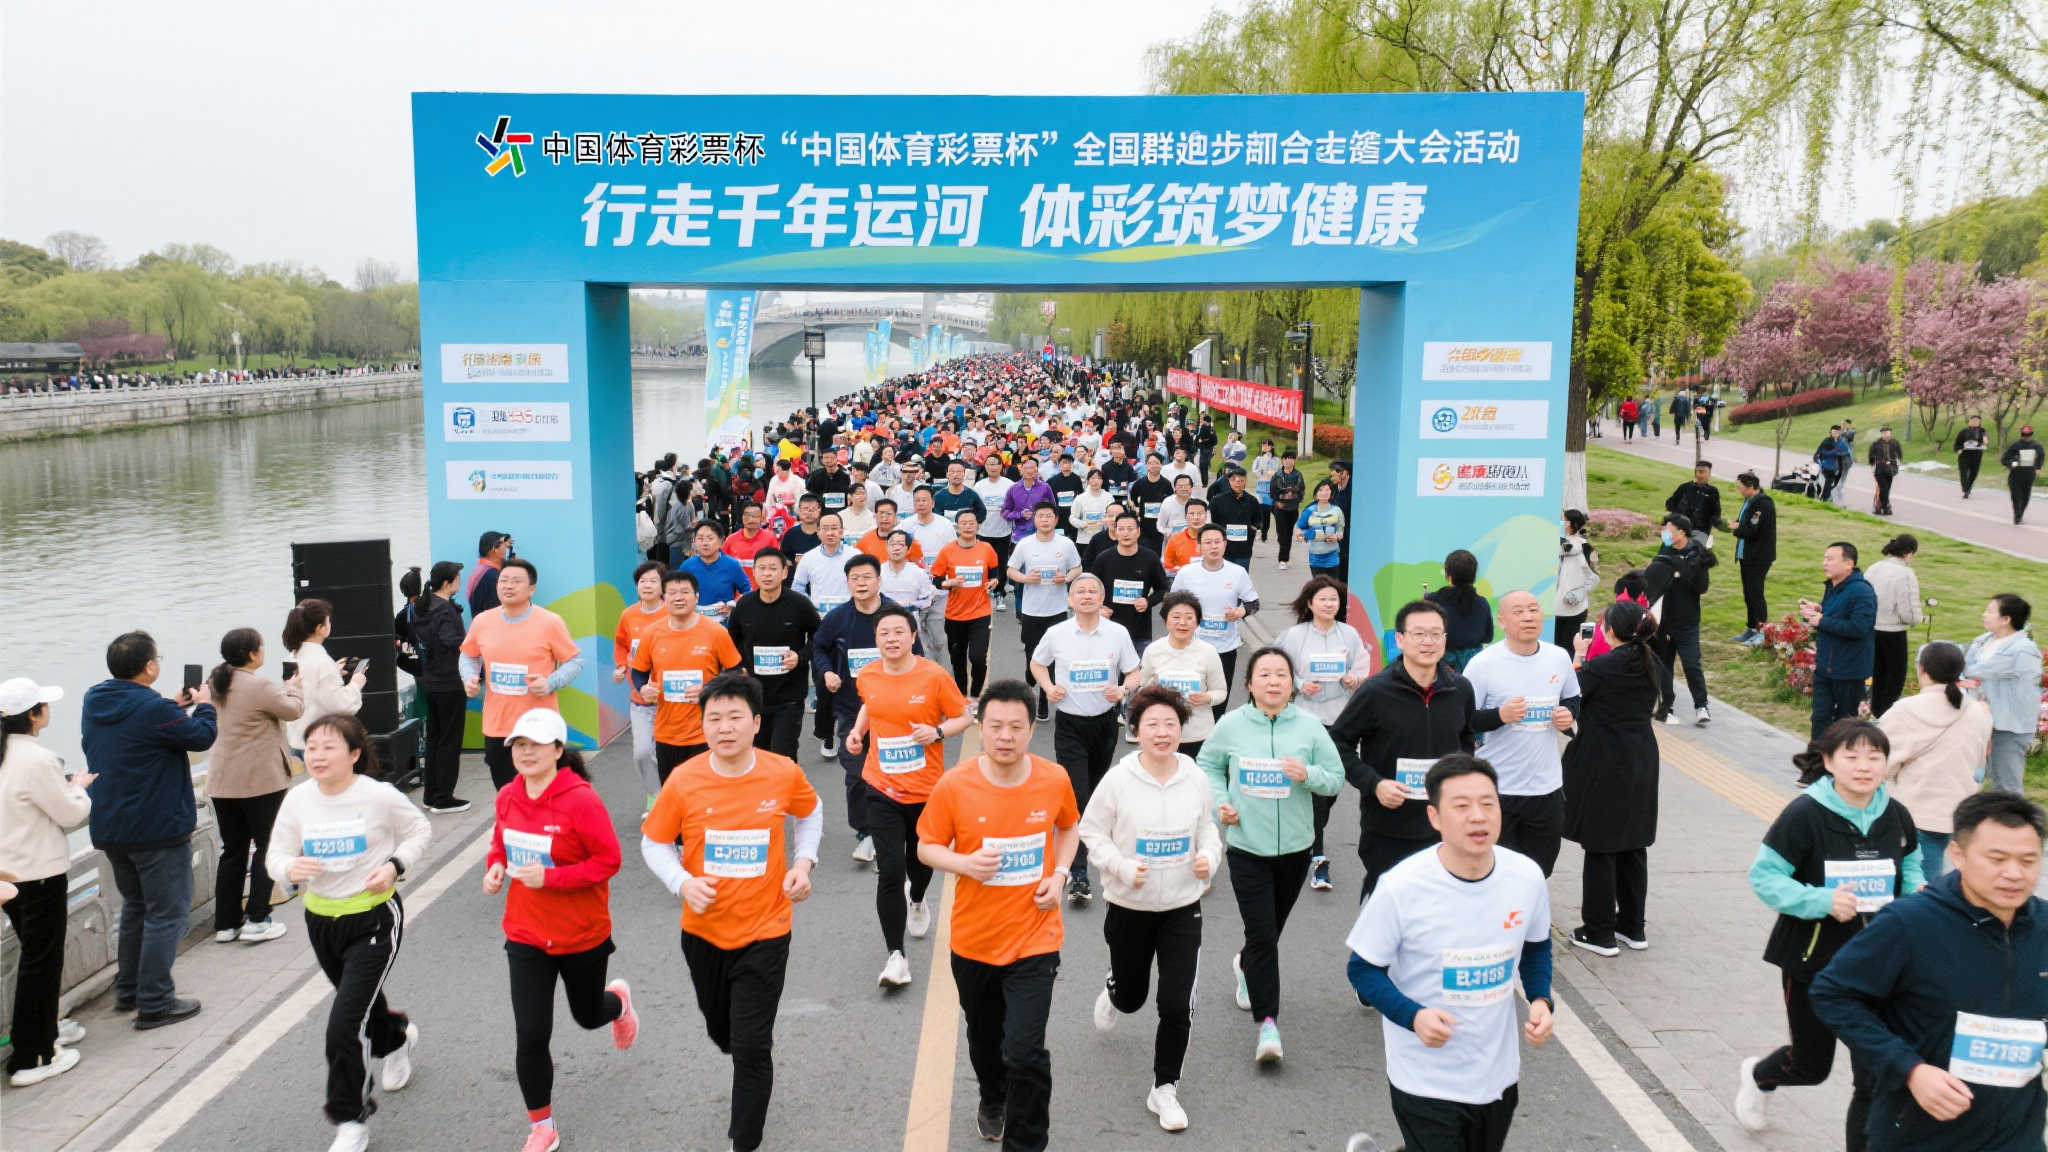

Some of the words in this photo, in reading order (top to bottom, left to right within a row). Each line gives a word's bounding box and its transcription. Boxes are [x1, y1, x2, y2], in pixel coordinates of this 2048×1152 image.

[542, 131, 766, 166] 中国体育彩票杯
[581, 182, 989, 248] 行走千年运河
[1020, 181, 1428, 248] 体彩筑梦健康
